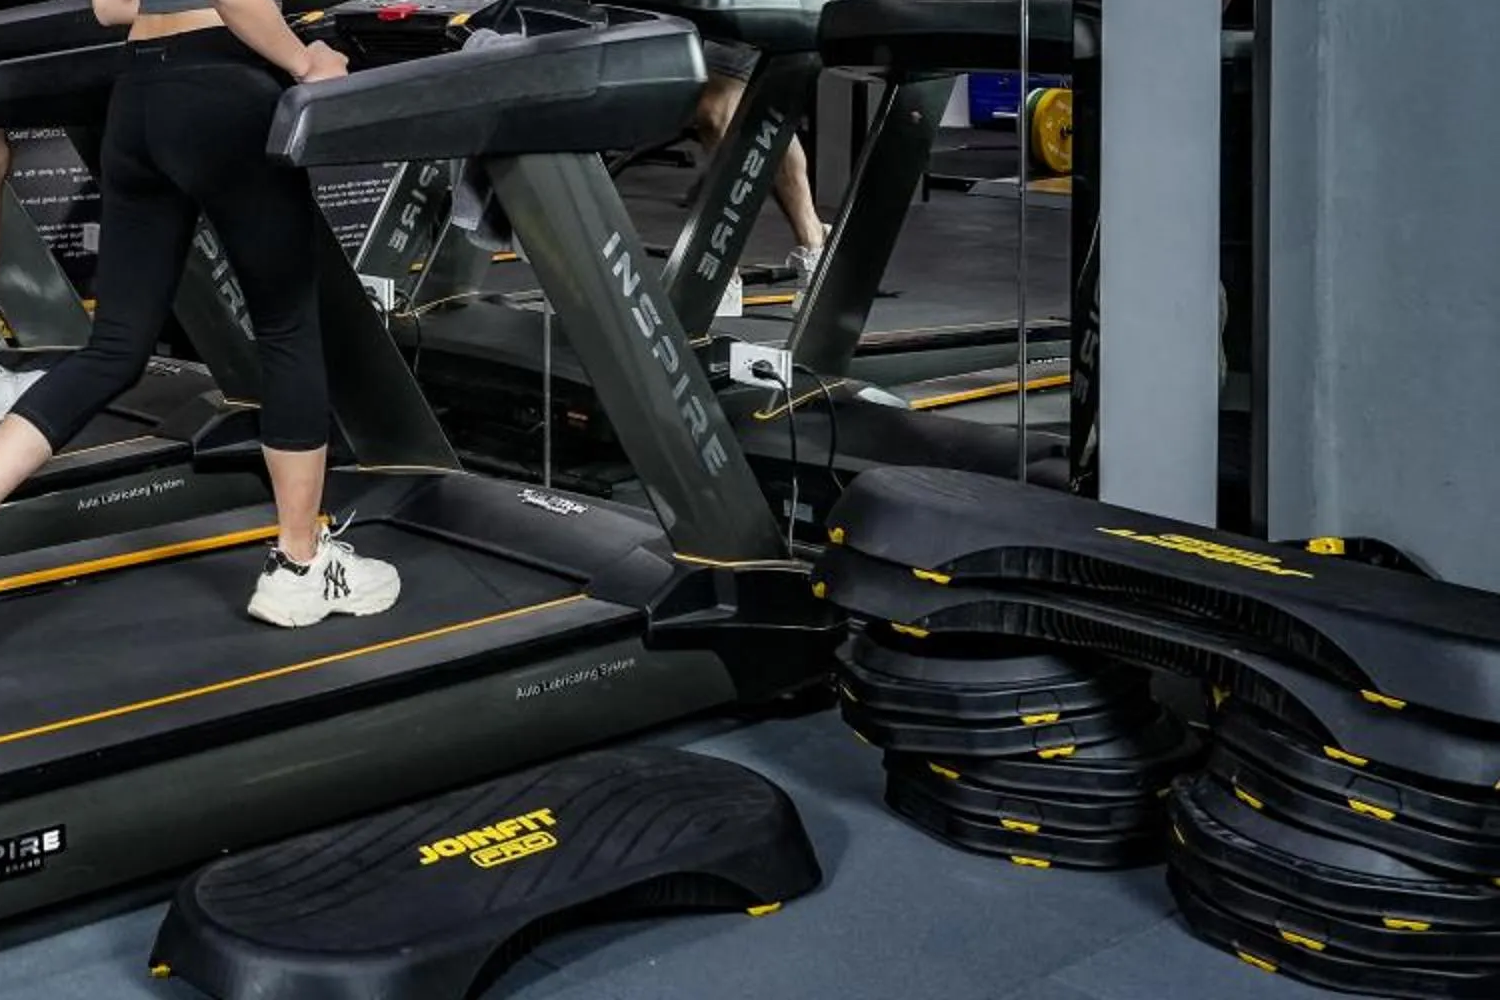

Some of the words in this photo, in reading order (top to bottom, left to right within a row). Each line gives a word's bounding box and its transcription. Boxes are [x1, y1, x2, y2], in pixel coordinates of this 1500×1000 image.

[192, 229, 257, 341] PIRE
[603, 231, 728, 477] INSPIRE
[516, 683, 541, 701] Auto
[419, 807, 556, 865] JOINFIT
[477, 834, 550, 864] PRO
